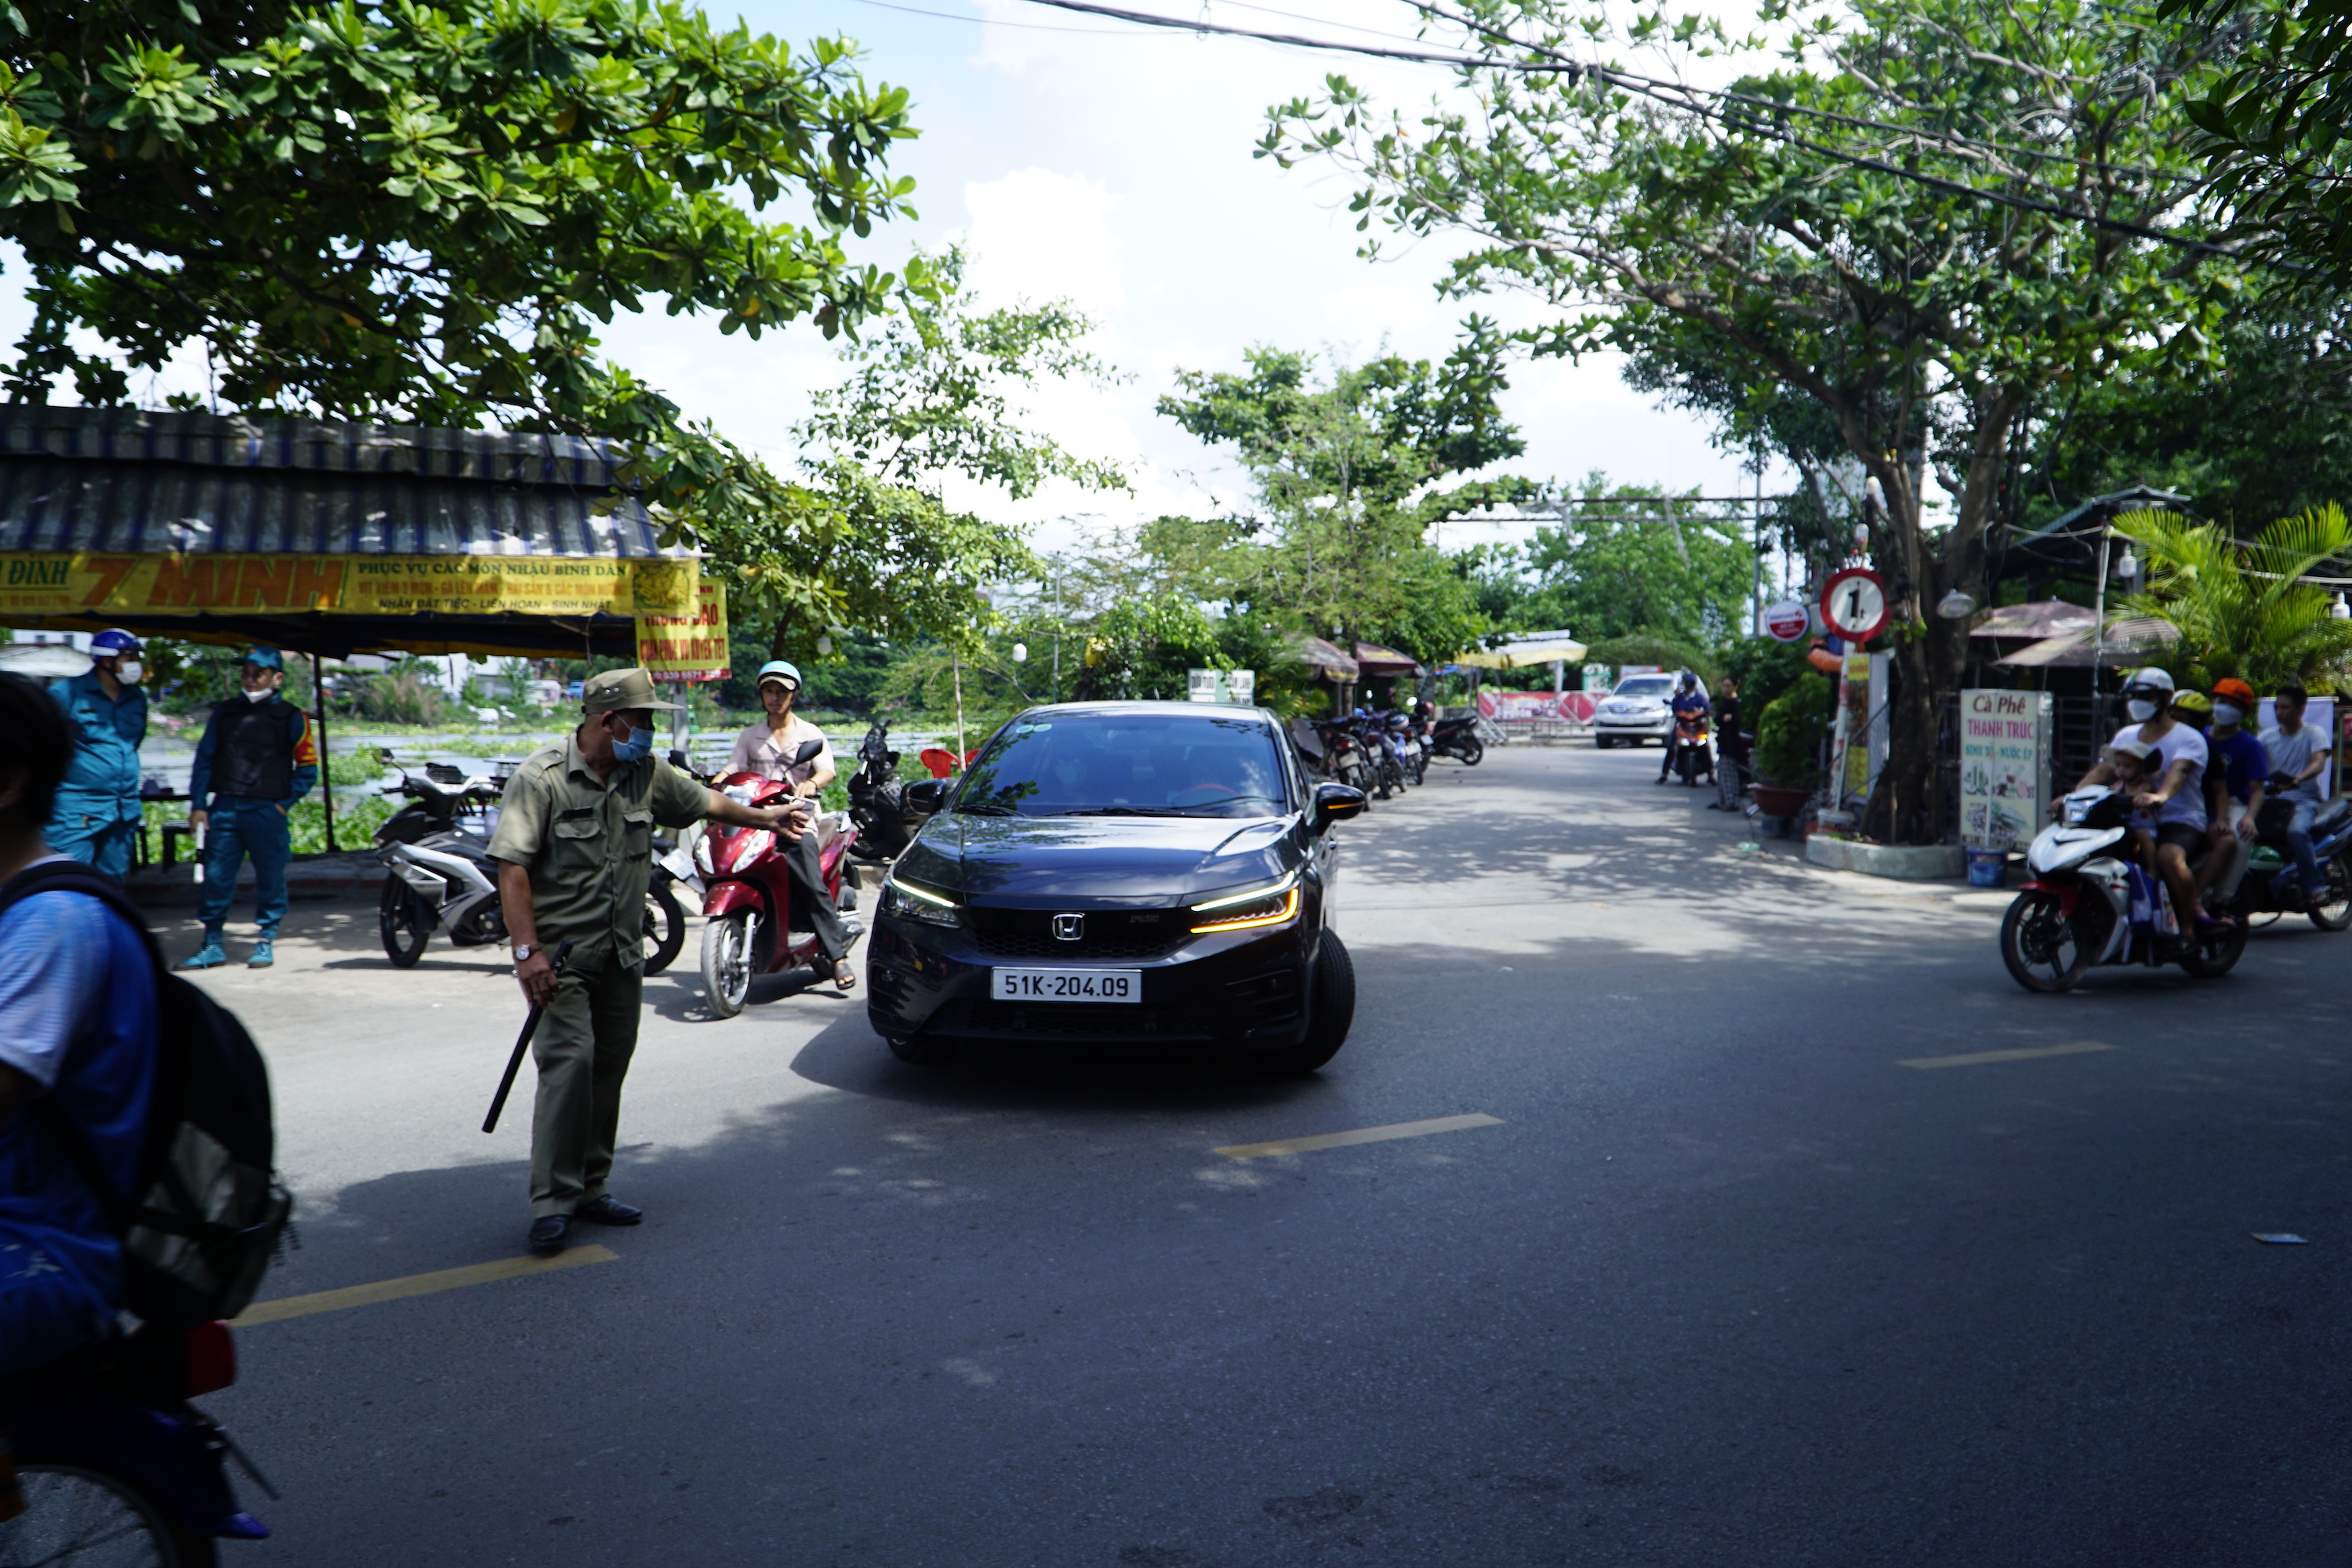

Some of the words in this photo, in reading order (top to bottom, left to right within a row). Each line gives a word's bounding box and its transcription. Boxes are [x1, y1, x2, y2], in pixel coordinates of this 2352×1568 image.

[9, 553, 69, 585] ĐÌNH
[358, 562, 401, 576] PHỤC
[405, 562, 427, 576] VỤ
[433, 561, 464, 574] CÁC
[468, 561, 502, 574] MÓN
[555, 561, 590, 575] BÌNH
[596, 562, 626, 576] DÂN
[80, 557, 137, 606] 7
[147, 559, 346, 607] MINH
[480, 597, 506, 608] LIÊN
[510, 600, 542, 609] HOAN
[552, 601, 578, 610] SINH
[1973, 695, 1992, 713] Cà
[1997, 695, 2027, 714] Phê
[1968, 719, 2003, 738] THANH
[2006, 718, 2034, 740] TRÚC
[1005, 975, 1128, 997] 51K-204.09
